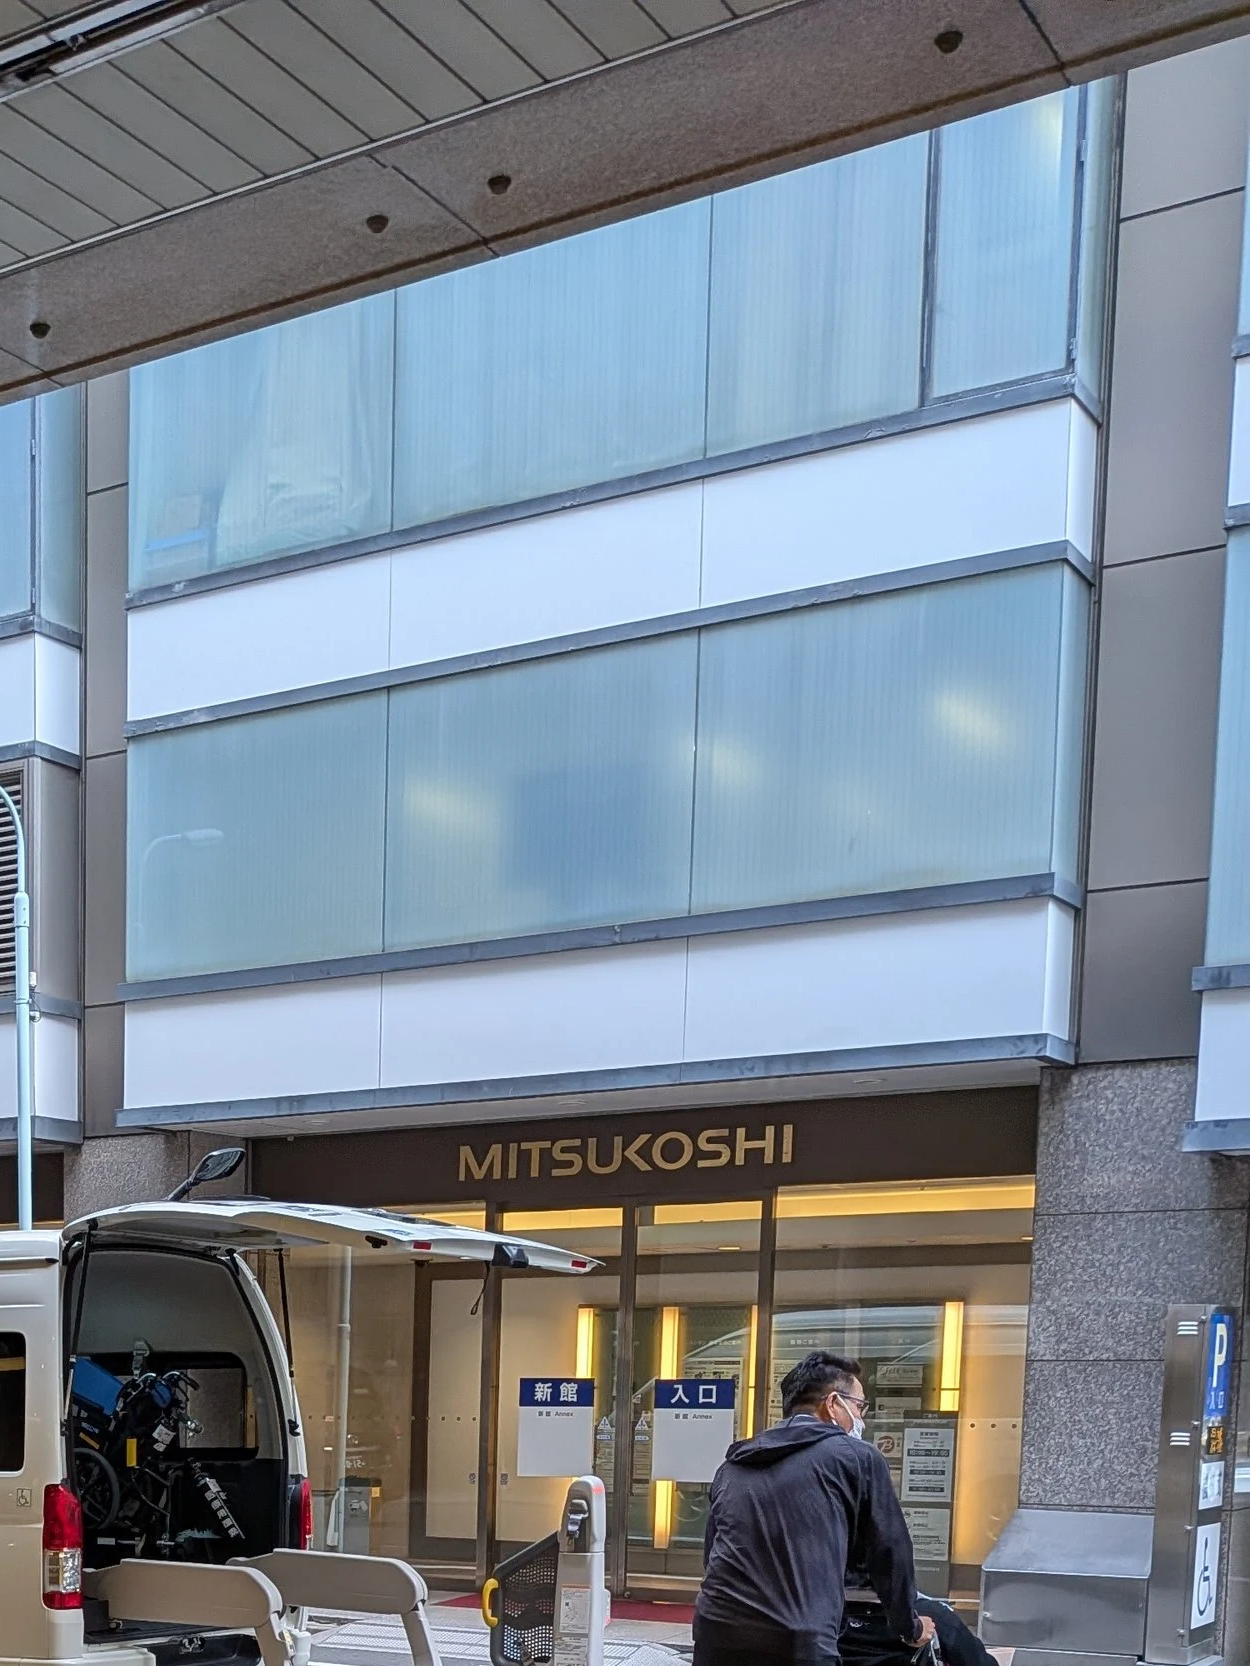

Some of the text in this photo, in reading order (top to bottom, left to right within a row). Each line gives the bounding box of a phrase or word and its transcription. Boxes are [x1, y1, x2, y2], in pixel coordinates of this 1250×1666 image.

[458, 1124, 794, 1182] MITSUKOSHI
[1212, 1323, 1228, 1388] P
[534, 1382, 578, 1402] 新館
[670, 1384, 717, 1404] 入口
[554, 1410, 574, 1418] Annex
